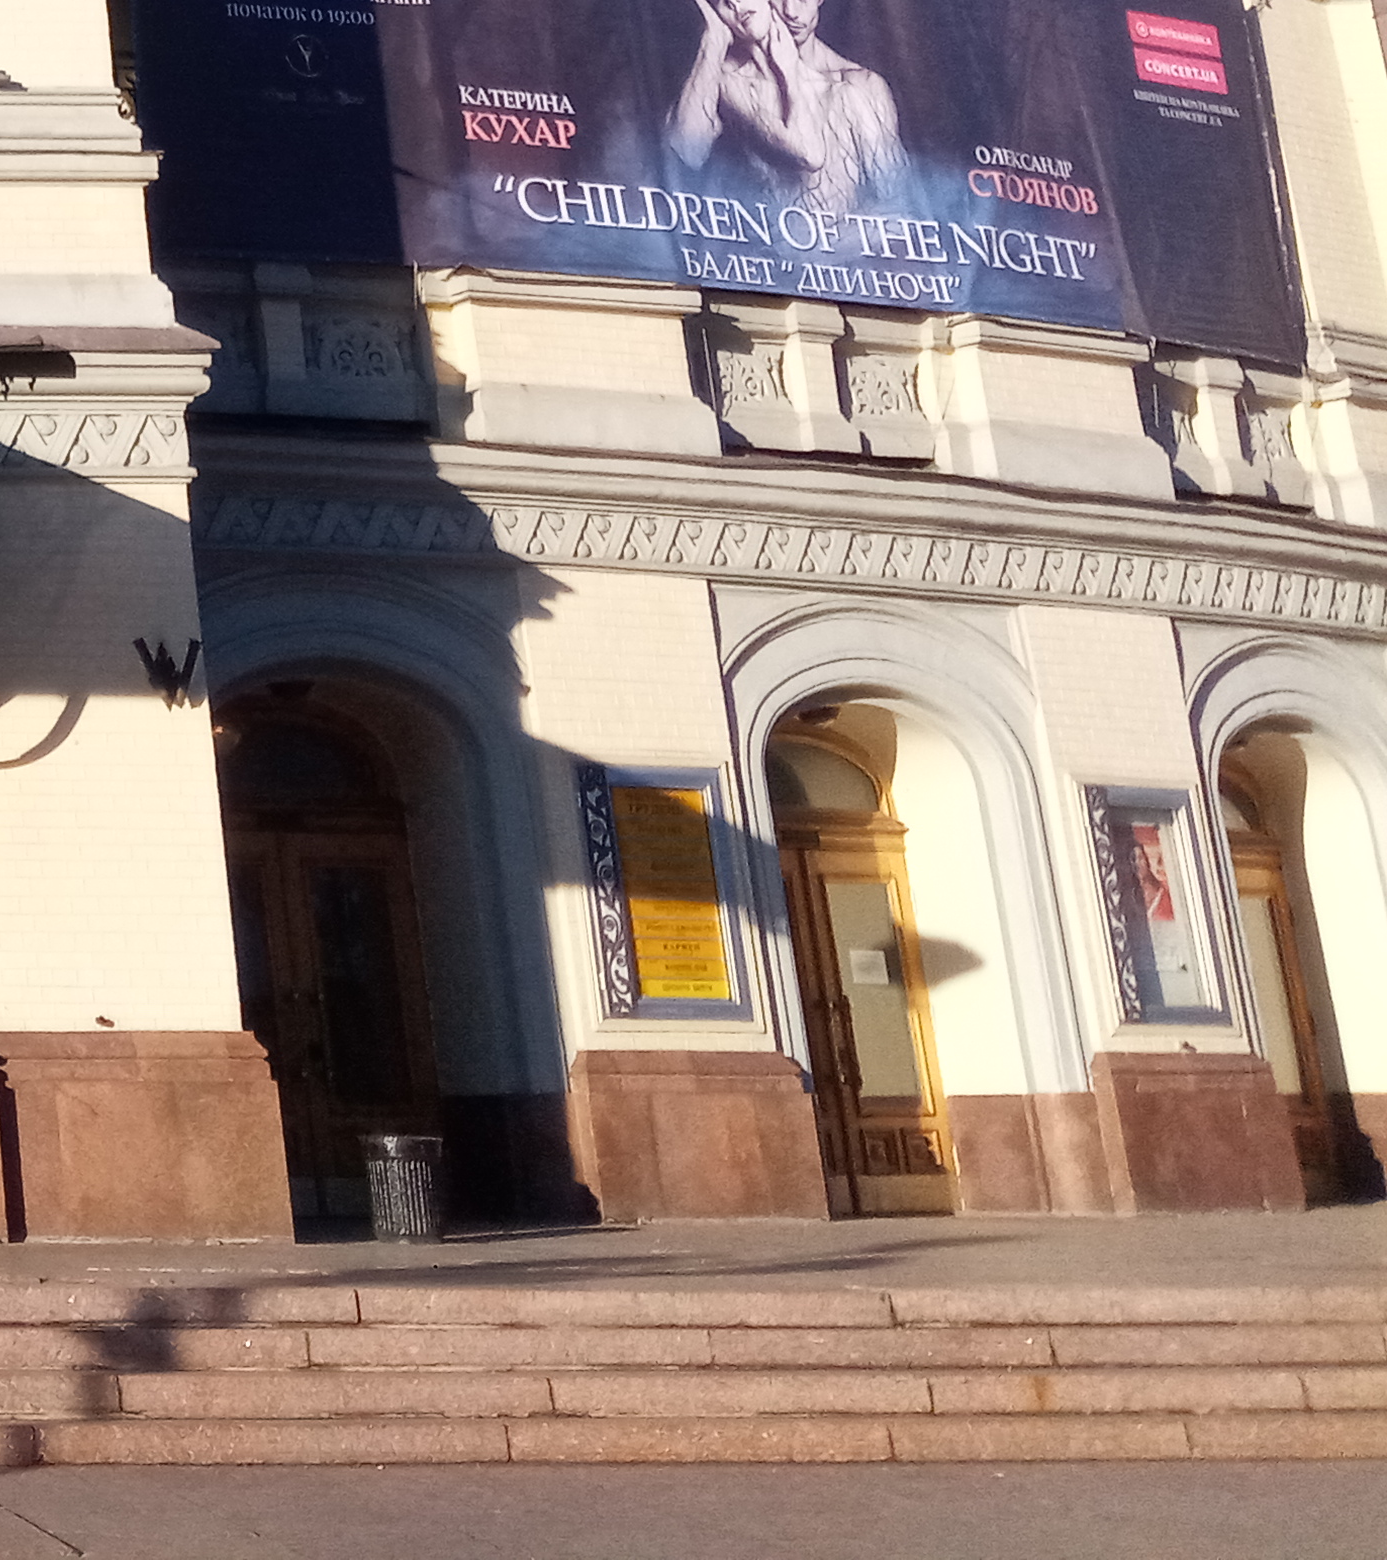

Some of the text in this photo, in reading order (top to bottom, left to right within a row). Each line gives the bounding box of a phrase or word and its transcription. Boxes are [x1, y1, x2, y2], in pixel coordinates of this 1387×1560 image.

[328, 9, 376, 27] 19:00
[1143, 59, 1219, 85] CONCERT.UA
[459, 84, 576, 115] КАТЕРИНА
[461, 110, 577, 149] КУХАР
[975, 145, 1073, 182] ОЛЕКСАНДР
[968, 168, 1099, 215] СТОЯНОВ
[778, 205, 841, 253] OF
[844, 212, 949, 265] THE
[681, 247, 777, 287] БАЛЕТ
